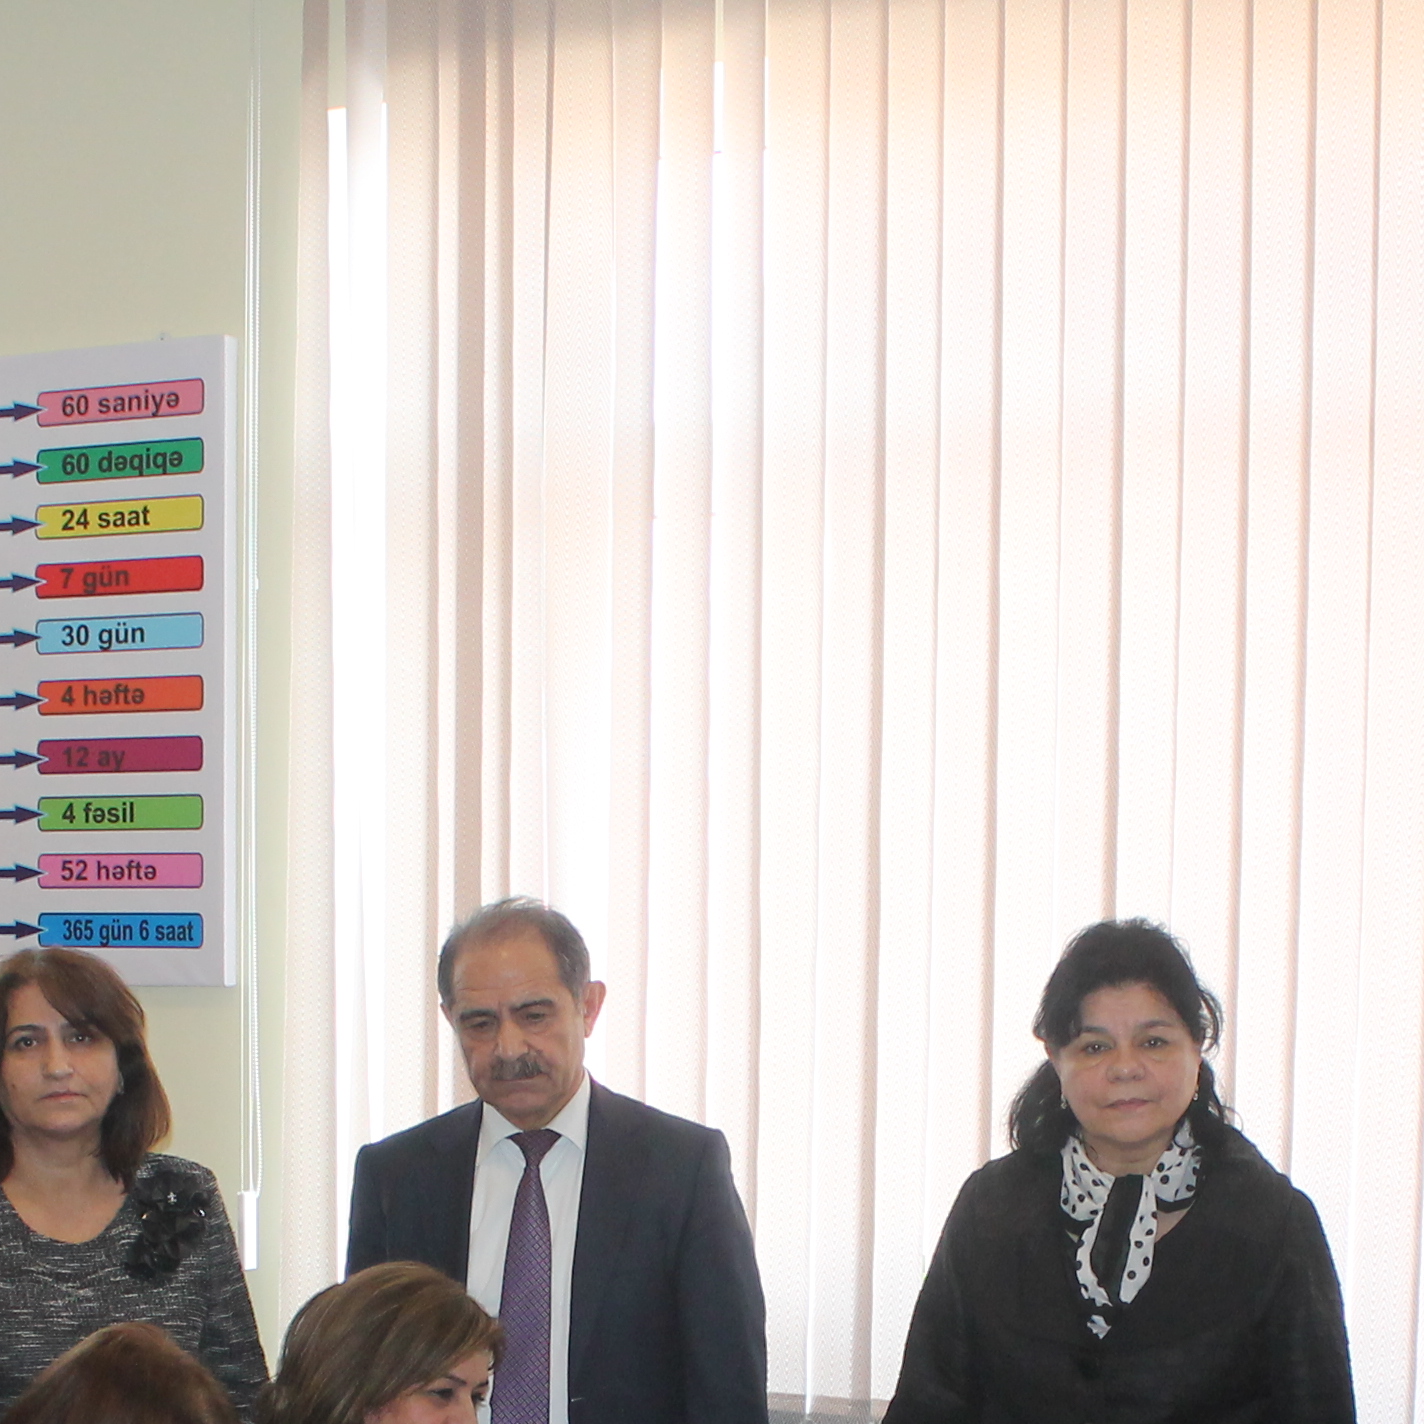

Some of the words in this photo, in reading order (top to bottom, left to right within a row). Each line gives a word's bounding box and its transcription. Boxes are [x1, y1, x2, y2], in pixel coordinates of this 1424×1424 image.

[61, 395, 89, 417] 60
[98, 388, 180, 417] saniyə
[61, 454, 90, 476] 60
[98, 446, 184, 476] dəqiqə
[61, 508, 90, 531] 24
[97, 505, 150, 528] saat
[60, 569, 74, 589] 7
[82, 567, 129, 597] gün
[61, 625, 90, 647] 30
[98, 623, 146, 651] gün
[61, 686, 75, 706] 4
[83, 684, 145, 705] həftə
[62, 747, 89, 767] 12
[97, 748, 126, 772] ay
[62, 803, 76, 823] 4
[83, 801, 135, 824] fəsil
[61, 861, 88, 881] 52
[96, 860, 157, 881] həftə
[62, 919, 94, 941] 365
[100, 920, 133, 946] gün
[139, 920, 150, 941] 6
[155, 920, 194, 942] saat
